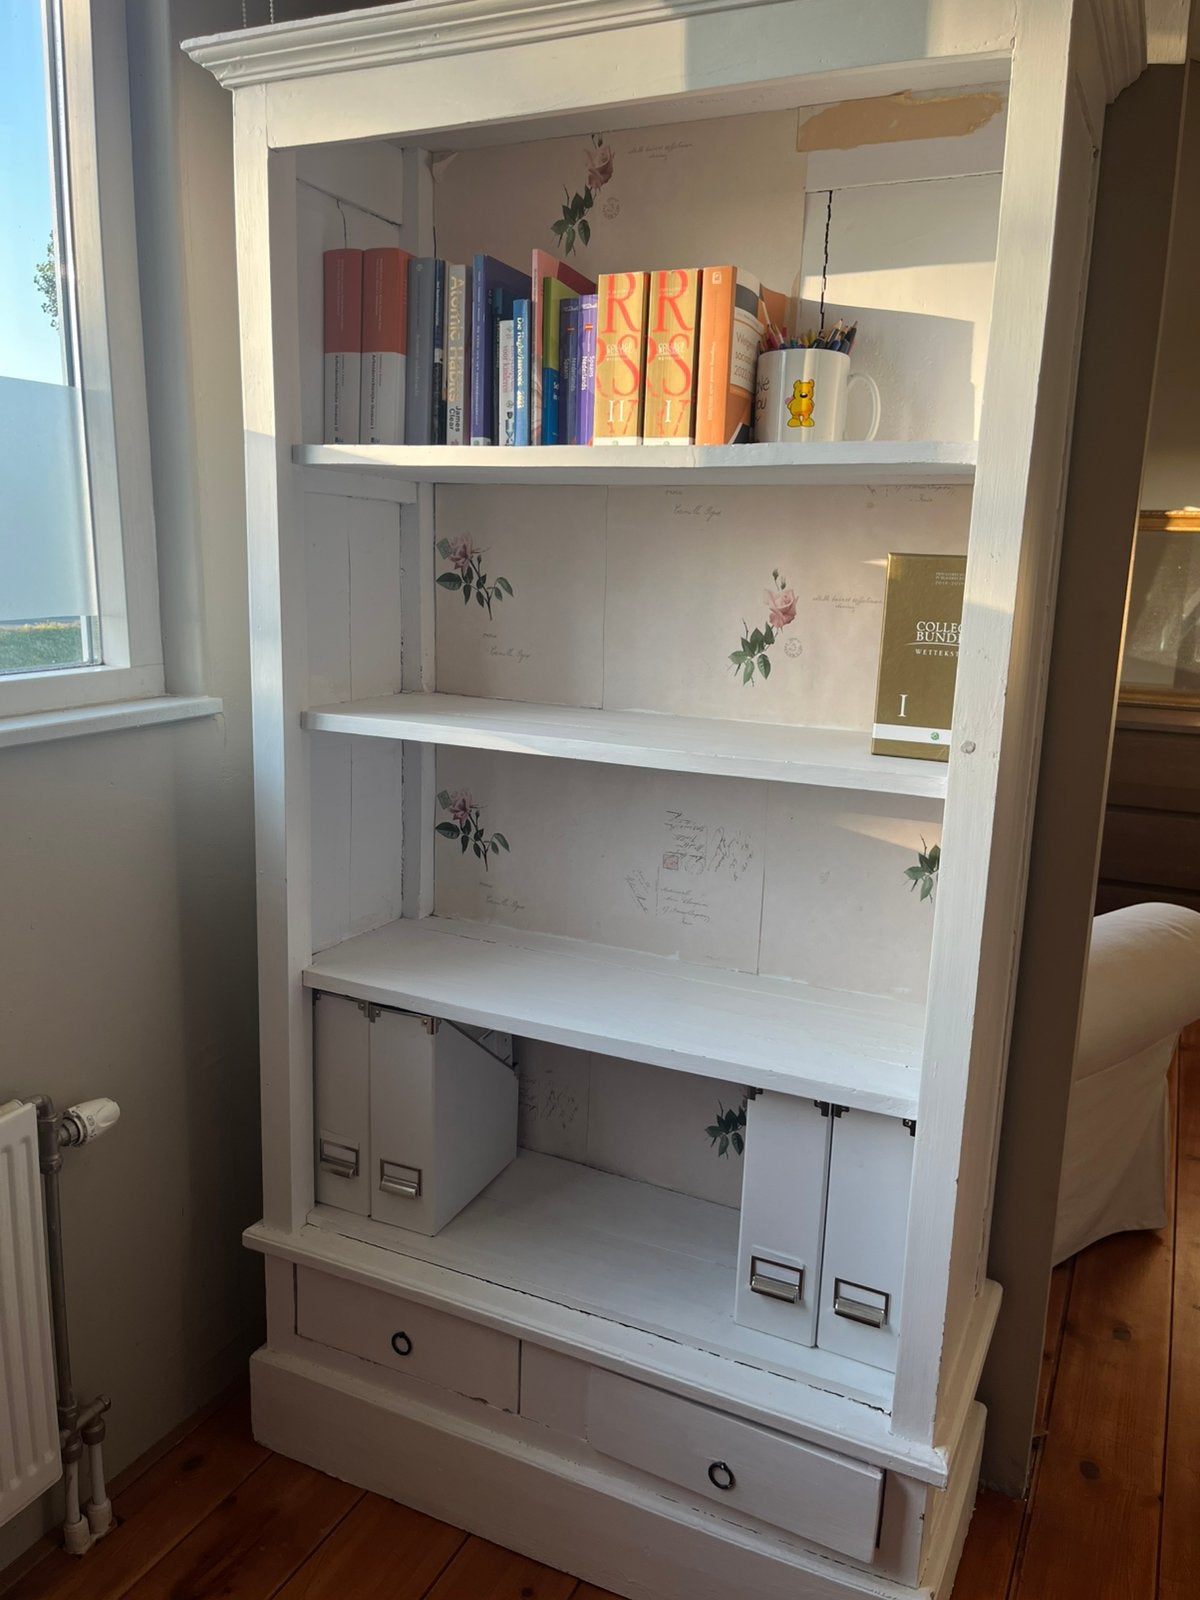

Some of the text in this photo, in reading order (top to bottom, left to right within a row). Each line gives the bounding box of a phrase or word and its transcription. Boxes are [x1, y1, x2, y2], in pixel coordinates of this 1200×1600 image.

[601, 272, 640, 334] R
[653, 269, 693, 333] R
[447, 276, 465, 402] Atomic Habits
[607, 399, 625, 423] II
[896, 693, 909, 718] I
